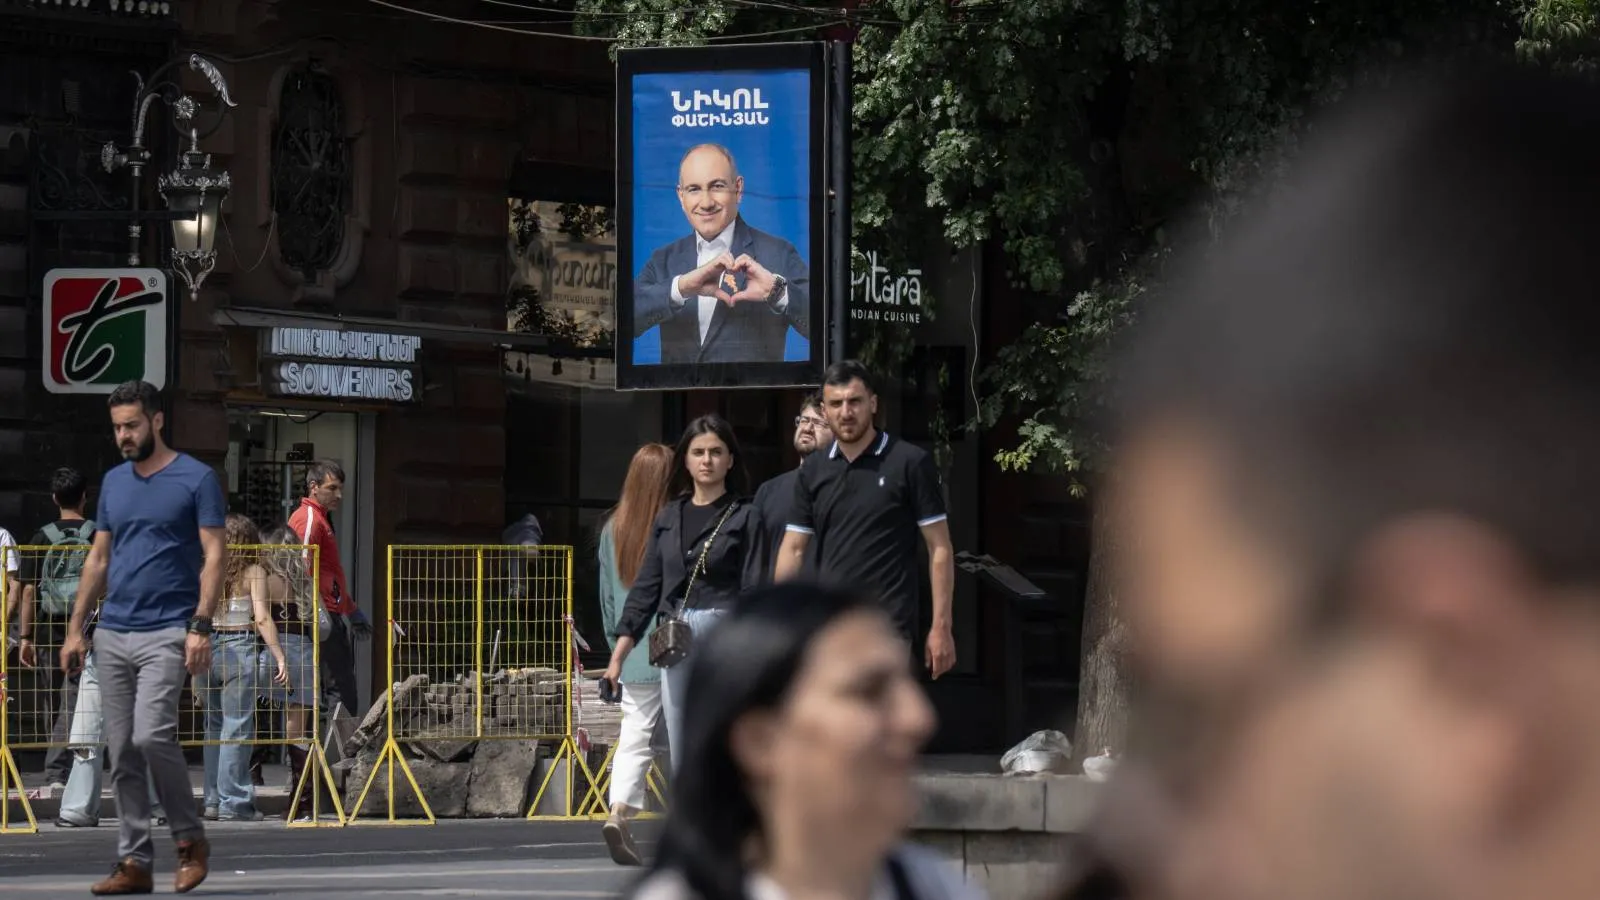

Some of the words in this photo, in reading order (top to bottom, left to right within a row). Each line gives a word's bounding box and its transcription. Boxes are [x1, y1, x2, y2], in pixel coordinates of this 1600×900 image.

[671, 88, 769, 112] ՆԻԿՈԼ
[671, 112, 769, 127] ՓԱՇԻՆՅԱՆ
[850, 308, 880, 320] NDIAN
[883, 311, 921, 324] CUISINE
[284, 362, 413, 401] SOUVENIRS
